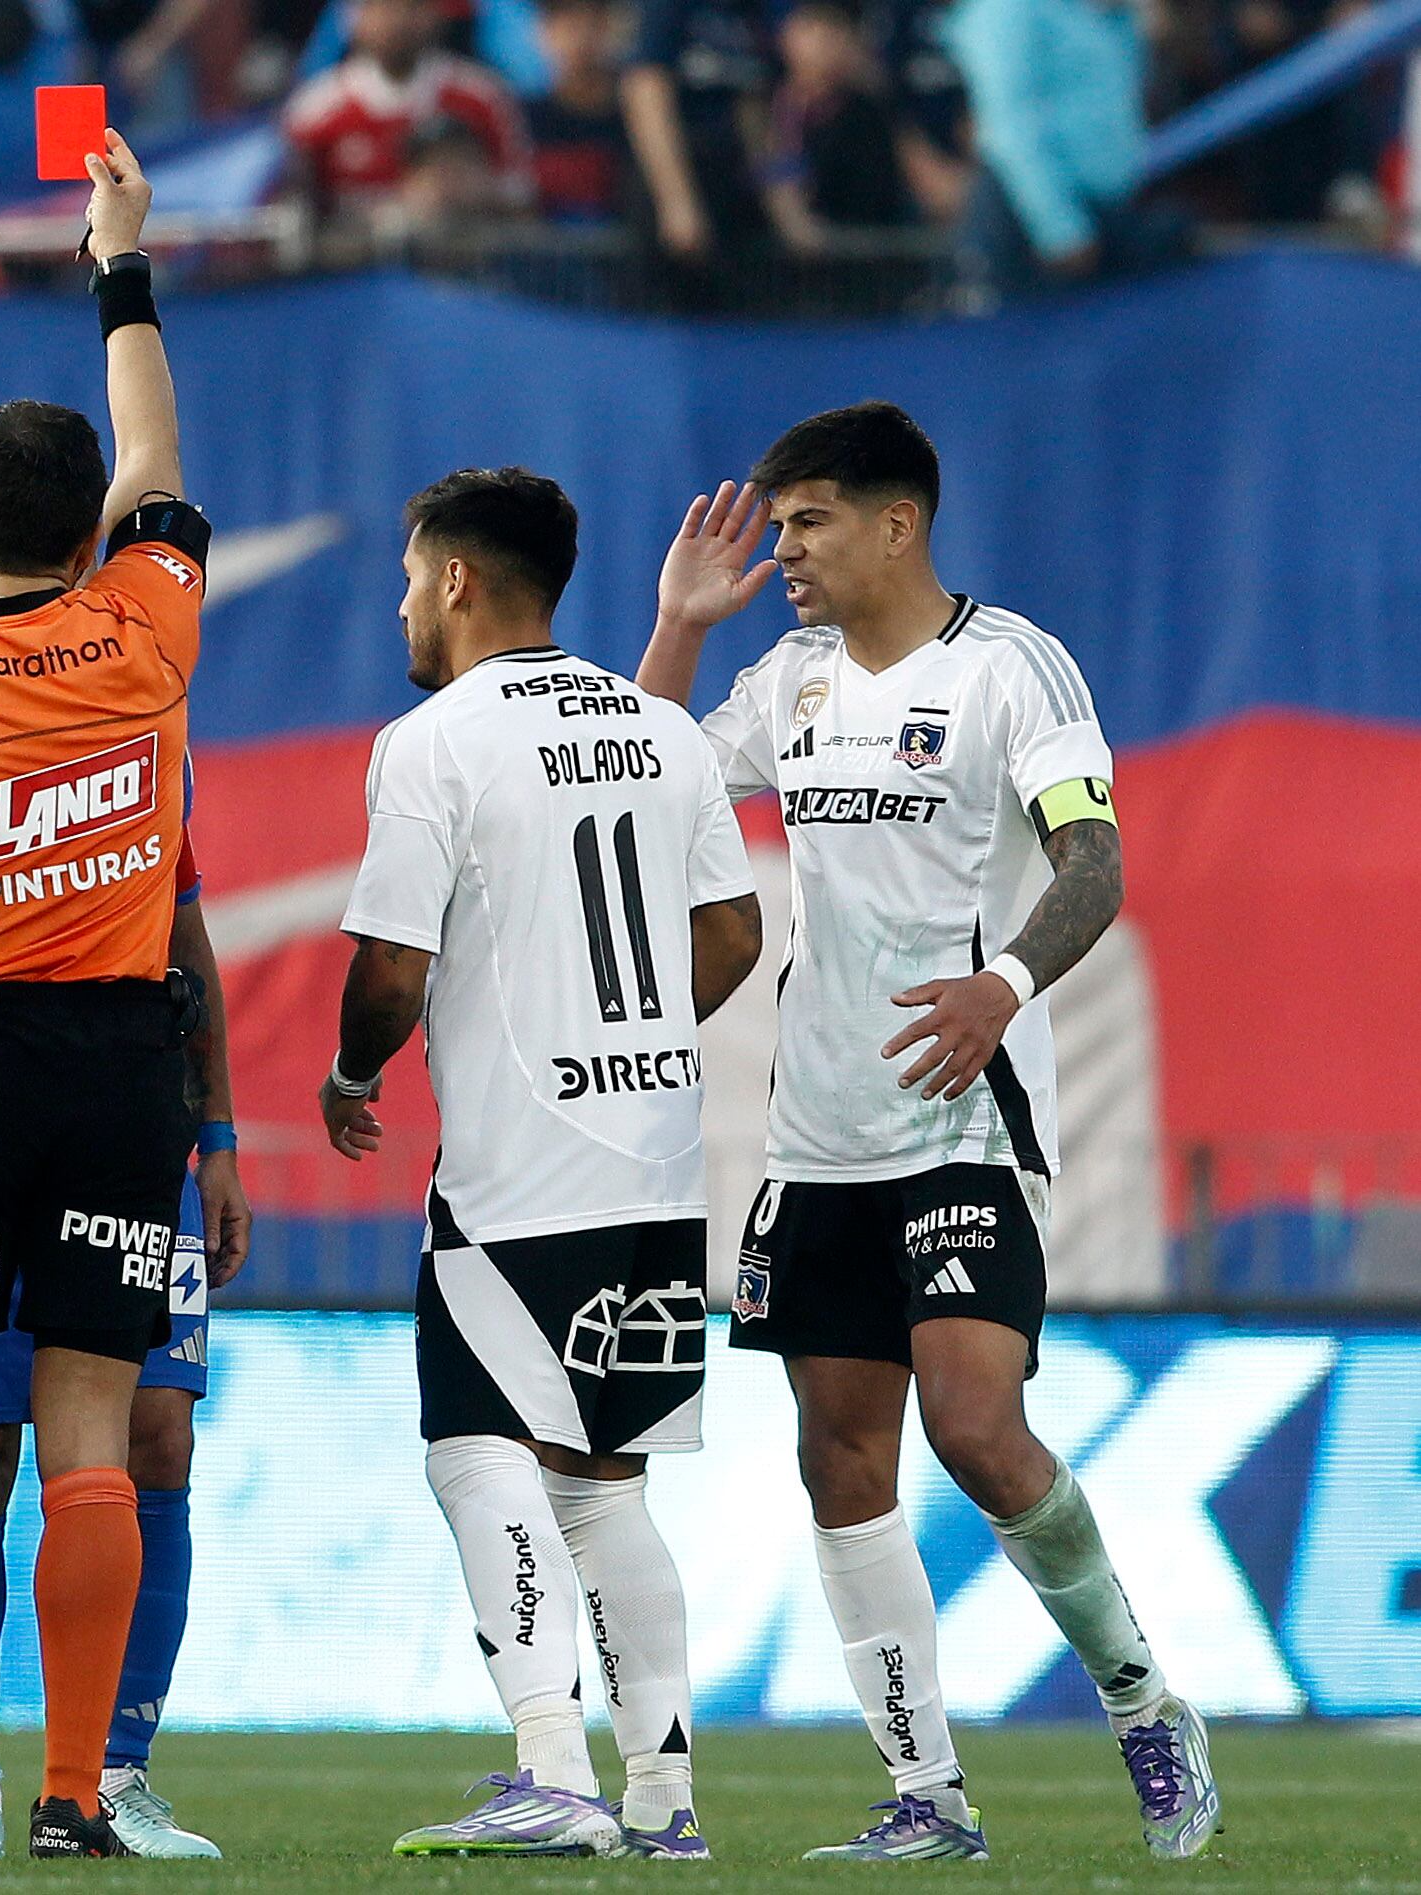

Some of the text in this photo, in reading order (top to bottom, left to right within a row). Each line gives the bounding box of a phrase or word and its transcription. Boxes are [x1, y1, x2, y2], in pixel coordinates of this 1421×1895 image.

[500, 673, 617, 699] ASSIST
[821, 735, 893, 747] JETOUR
[538, 738, 662, 787] BOLADOS
[800, 789, 948, 824] JUGABET
[573, 810, 663, 1023] 11
[60, 1209, 170, 1258] POWER
[905, 1204, 998, 1245] PHILIPS
[921, 1236, 933, 1254] &
[936, 1229, 996, 1250] Audio
[121, 1252, 166, 1292] ADE
[505, 1522, 545, 1648] AutoPlanet
[586, 1586, 622, 1708] AutoPlanet
[877, 1643, 921, 1763] AutoPlanet
[32, 1835, 80, 1851] balance
[41, 1826, 69, 1837] new
